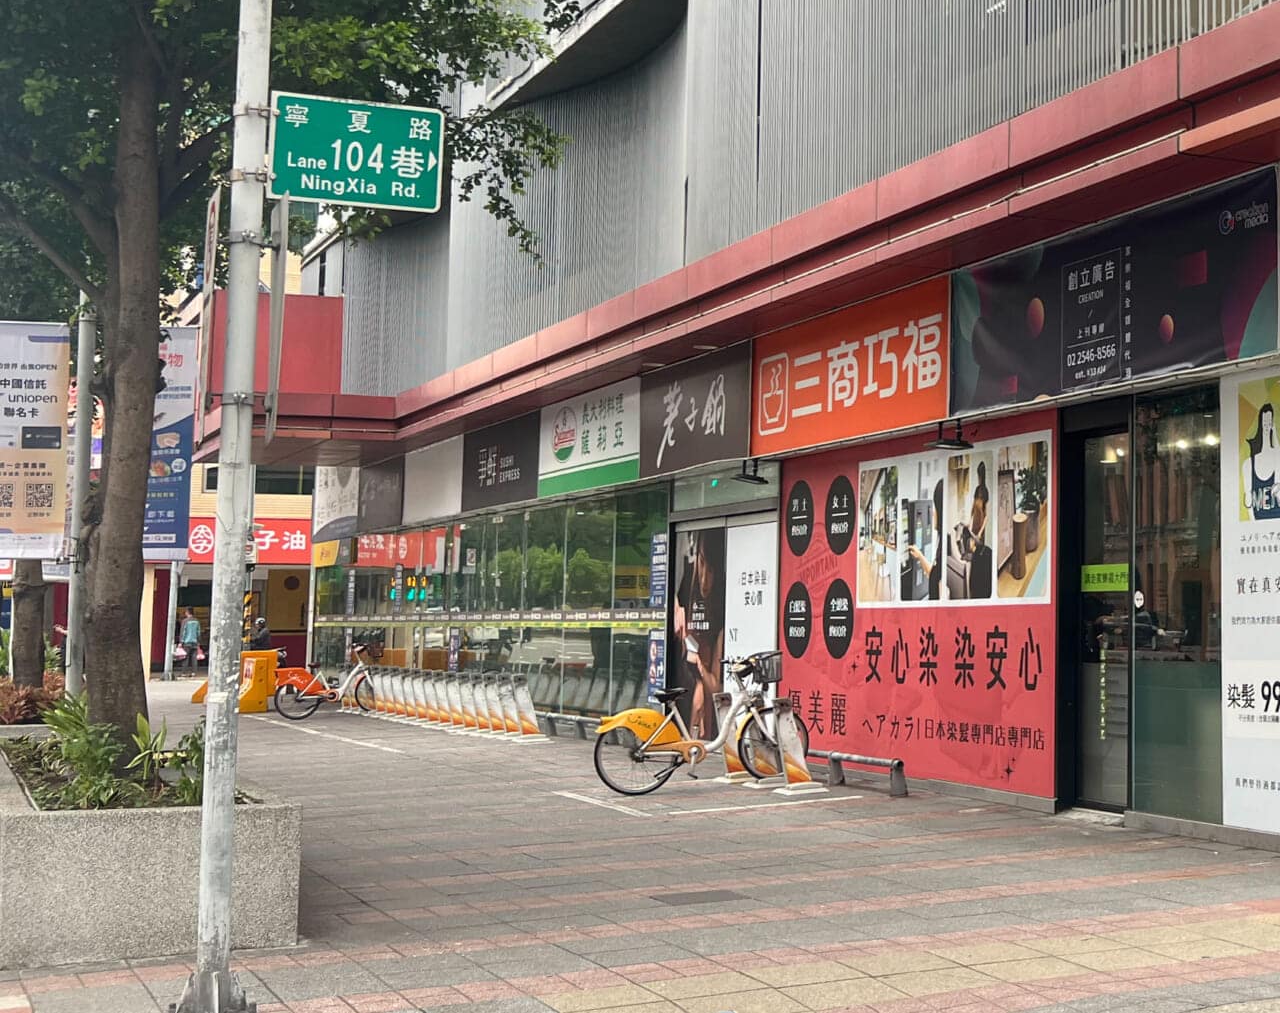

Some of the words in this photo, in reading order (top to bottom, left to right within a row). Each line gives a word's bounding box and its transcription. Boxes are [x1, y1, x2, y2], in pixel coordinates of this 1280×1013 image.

[285, 104, 433, 141] 寧夏路
[287, 151, 328, 170] Lane
[300, 173, 378, 196] NingXia
[391, 181, 421, 199] Rd.
[791, 313, 943, 419] 三商巧福
[8, 394, 58, 404] uniopen
[832, 494, 850, 508] 女士
[1227, 683, 1255, 709] 染髮
